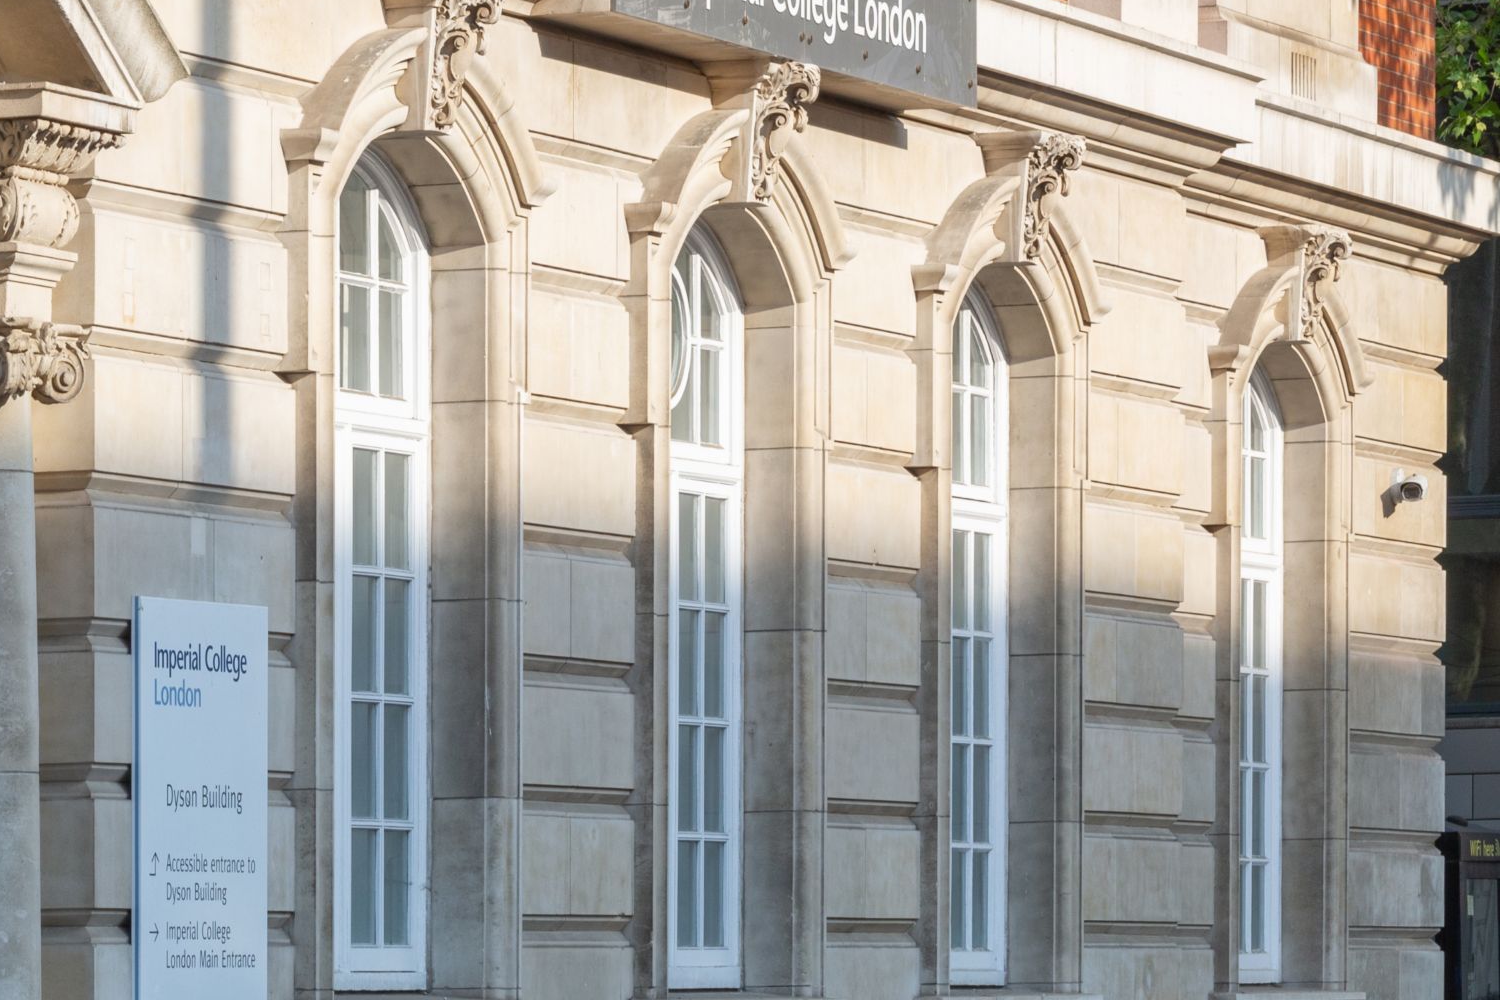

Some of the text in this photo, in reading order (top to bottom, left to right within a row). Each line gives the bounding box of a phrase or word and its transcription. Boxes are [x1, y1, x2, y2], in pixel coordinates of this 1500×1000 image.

[154, 640, 247, 683] Imperial College
[154, 678, 202, 708] London
[166, 783, 243, 815] Dyson Building
[165, 853, 256, 874] Accessible entrance to
[166, 882, 227, 906] Dyson Building
[166, 921, 231, 945] Imperial College
[166, 949, 257, 969] London Main Entrance
